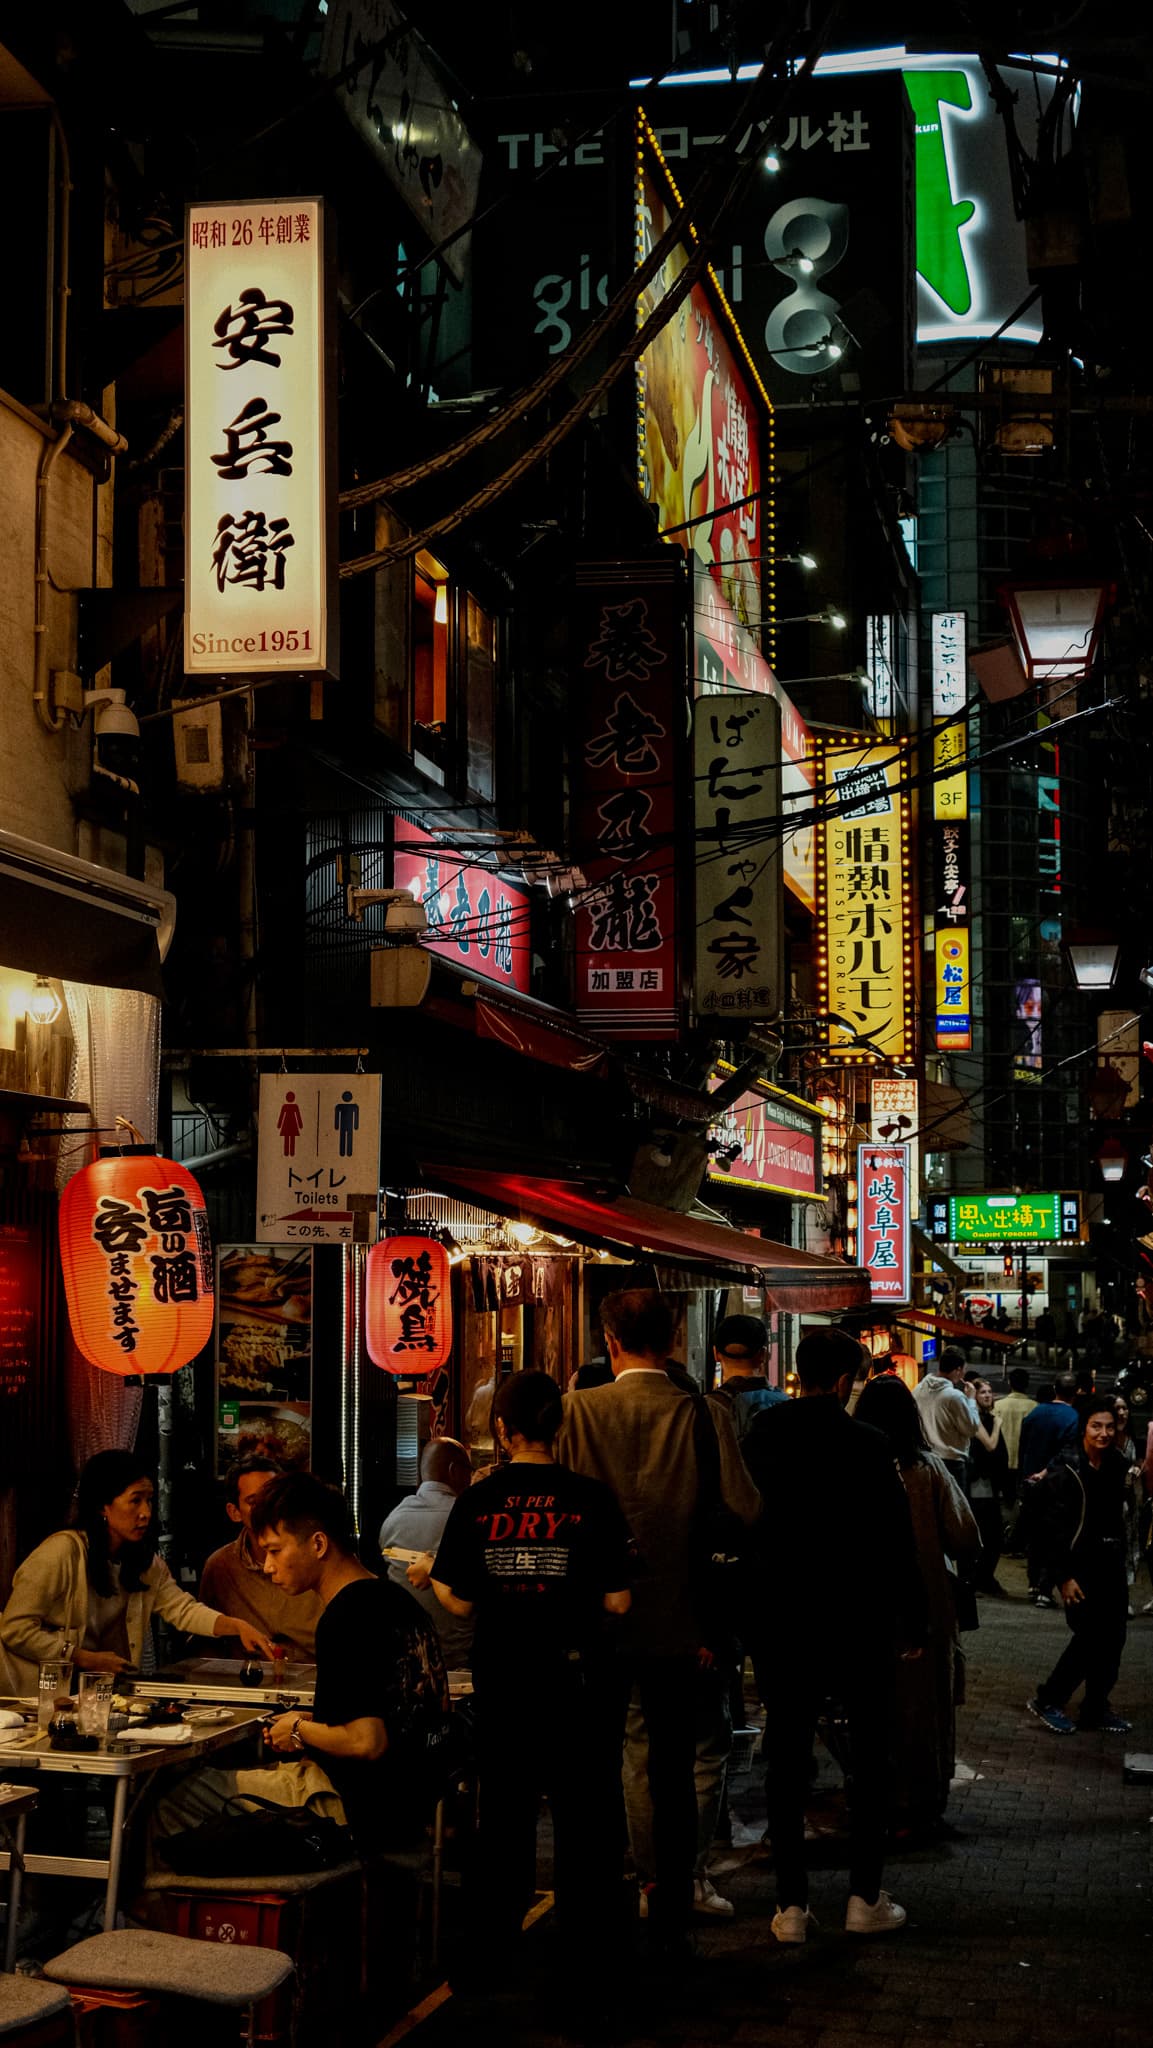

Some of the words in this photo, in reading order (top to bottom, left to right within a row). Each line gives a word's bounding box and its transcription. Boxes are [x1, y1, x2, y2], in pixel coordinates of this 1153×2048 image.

[192, 213, 310, 249] 昭和26年創業
[209, 287, 295, 594] 安兵衛
[191, 630, 313, 655] Since1951
[939, 791, 962, 806] 3F
[845, 827, 895, 1042] 情熱ホルモン
[590, 970, 663, 990] 加盟店
[835, 939, 847, 1046] HORUMN
[941, 963, 963, 1005] 松屋
[288, 1167, 347, 1188] トイレ
[294, 1191, 338, 1205] Toilets
[286, 1225, 352, 1239] この先、左
[867, 1175, 900, 1269] 岐阜屋
[933, 1203, 947, 1235] 新宿
[958, 1203, 1053, 1230] 思い出横丁
[1063, 1201, 1077, 1233] 西口
[141, 1186, 198, 1304] 旨い酒
[93, 1197, 149, 1353] 呑ませます
[870, 1280, 902, 1291] IFUYA
[515, 1552, 537, 1570] 生
